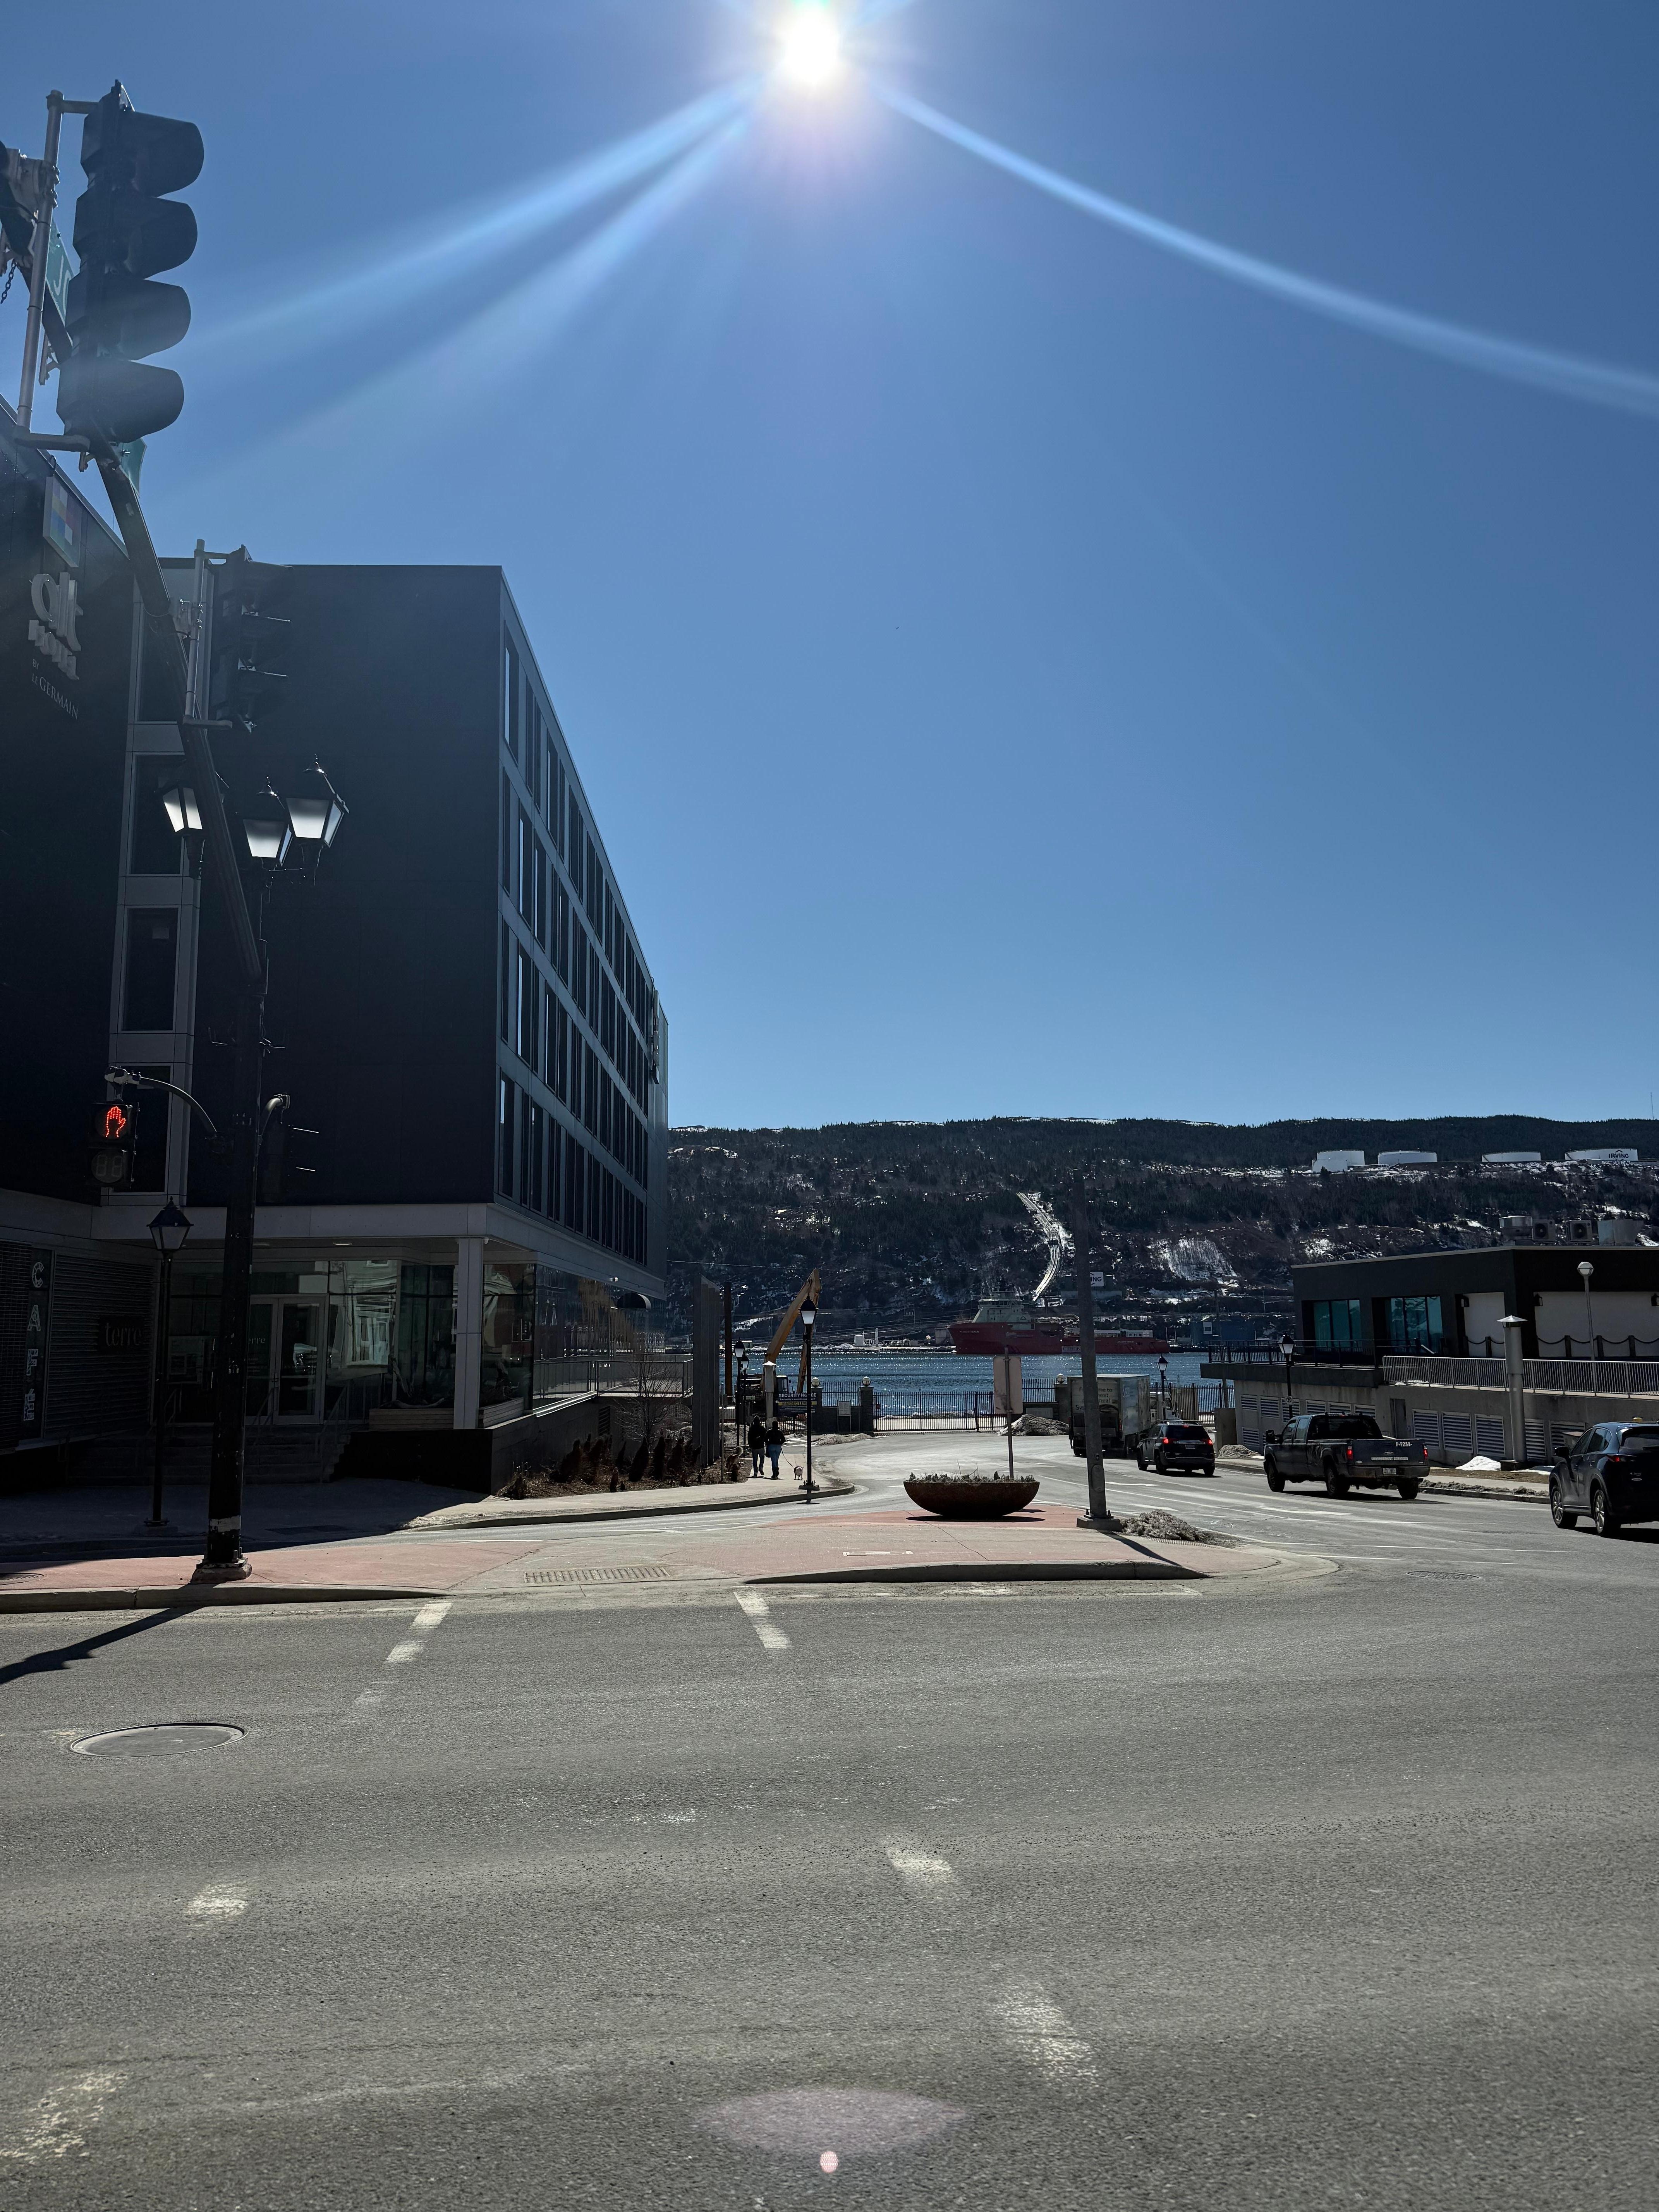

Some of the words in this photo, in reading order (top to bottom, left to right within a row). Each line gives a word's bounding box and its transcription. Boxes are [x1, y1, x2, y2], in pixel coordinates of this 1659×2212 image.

[33, 659, 39, 670] BY
[32, 673, 38, 685] LE
[40, 677, 77, 719] GERMAIN
[105, 1322, 142, 1346] terre
